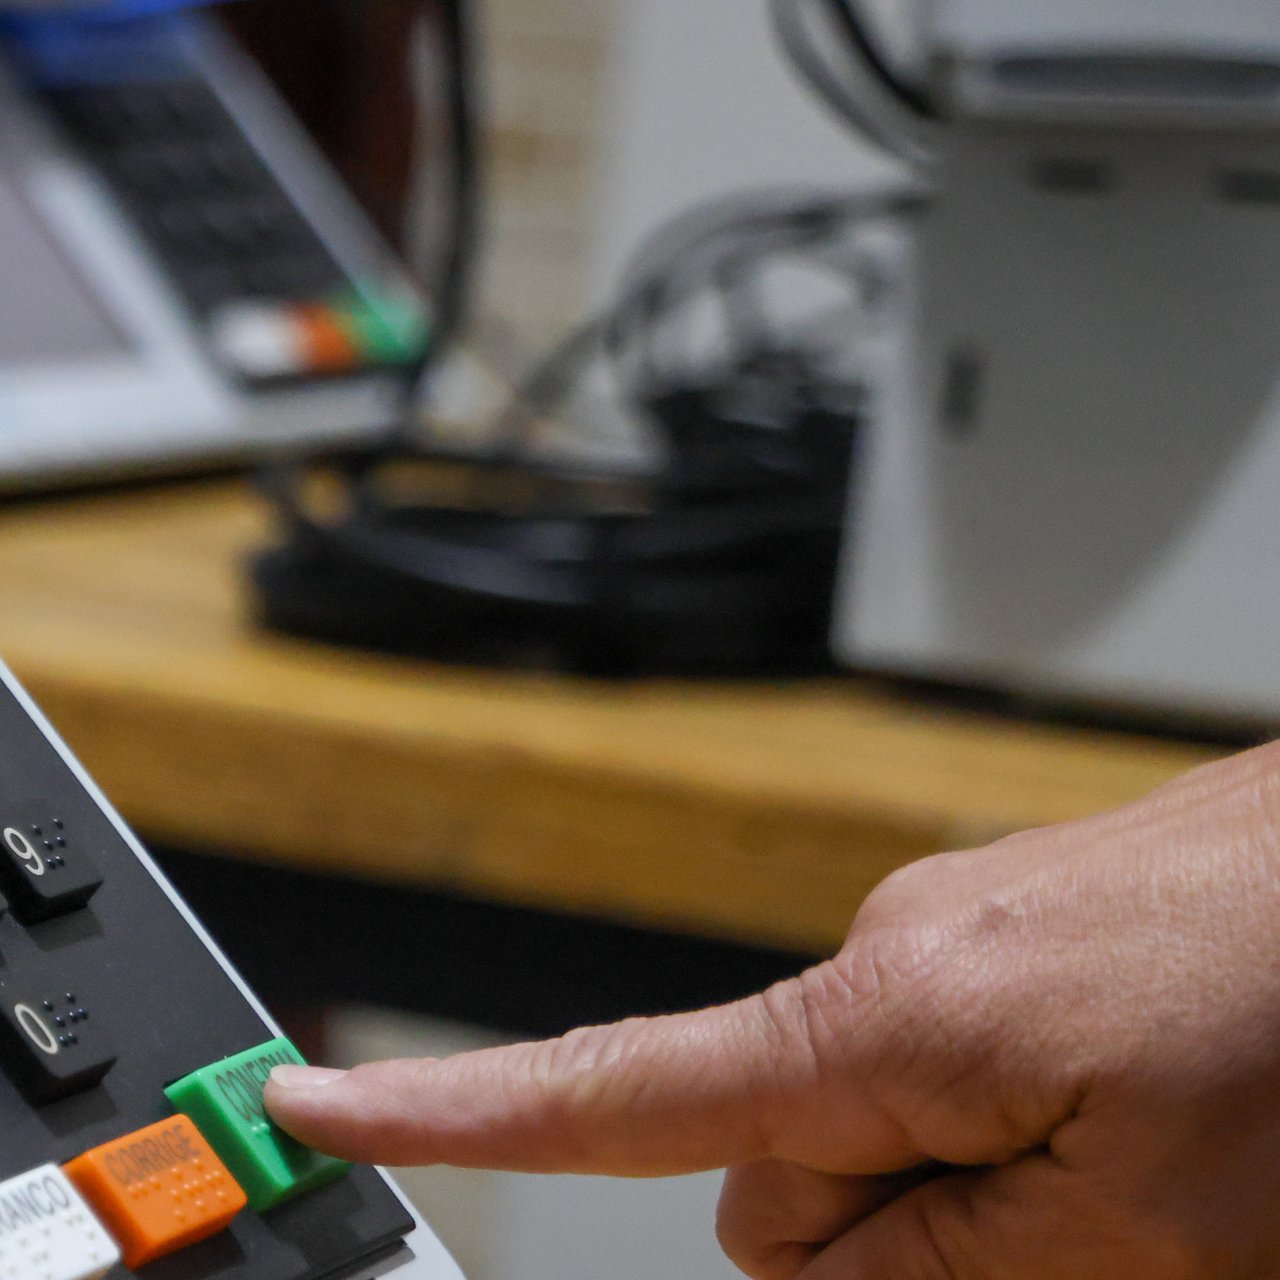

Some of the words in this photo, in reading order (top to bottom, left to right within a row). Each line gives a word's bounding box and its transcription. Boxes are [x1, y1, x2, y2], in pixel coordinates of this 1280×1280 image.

[3, 826, 45, 876] 9
[14, 1003, 59, 1055] 0
[104, 1124, 201, 1186] CORRIGE
[215, 1048, 299, 1122] CONF
